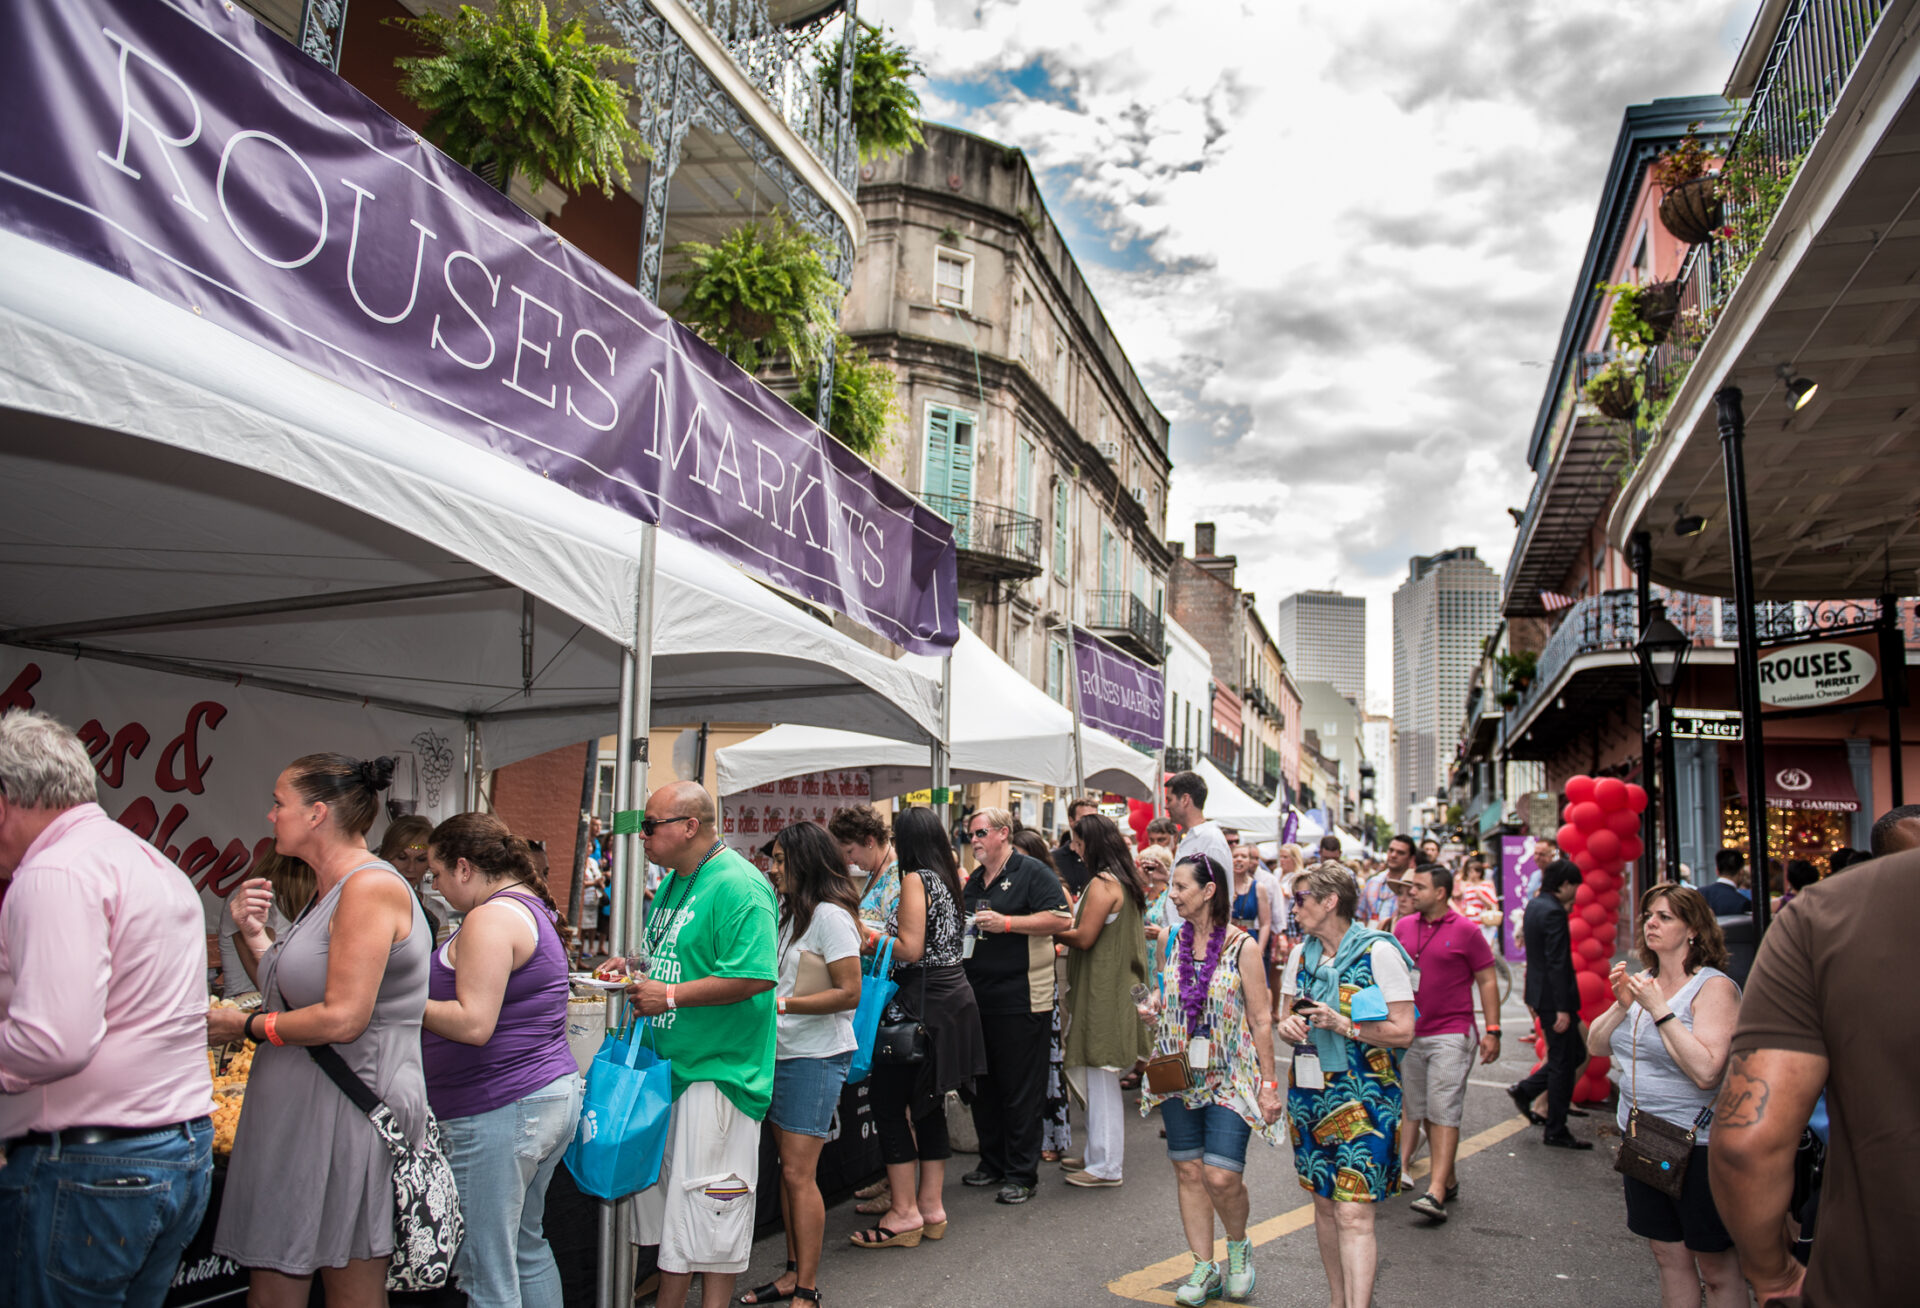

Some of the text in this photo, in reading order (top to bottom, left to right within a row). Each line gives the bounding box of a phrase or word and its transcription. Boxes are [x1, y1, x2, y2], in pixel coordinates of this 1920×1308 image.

[97, 27, 886, 589] ROUSES MARKETS
[1759, 650, 1852, 685] ROUSES
[1815, 675, 1861, 689] MARKET
[1772, 687, 1850, 704] Louisiana Owned
[1690, 719, 1740, 736] Peter
[155, 701, 228, 795] &
[1801, 799, 1858, 812] GAMBINO
